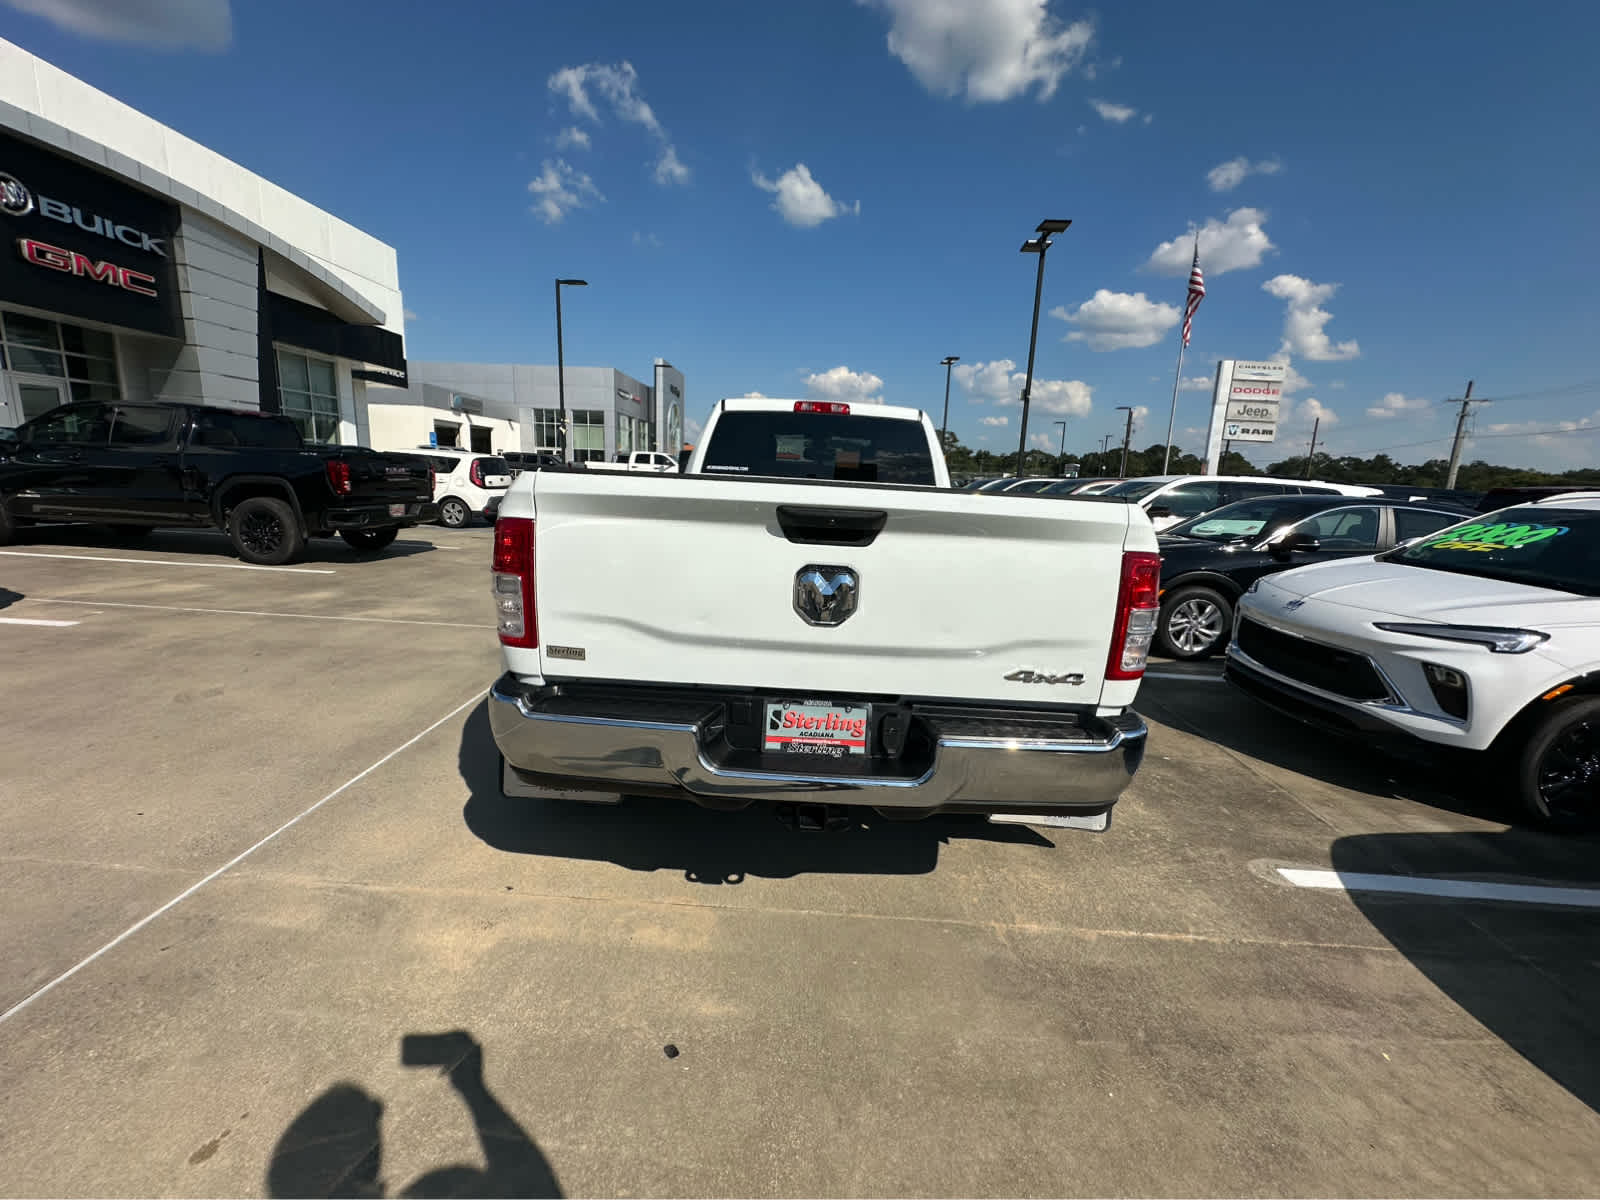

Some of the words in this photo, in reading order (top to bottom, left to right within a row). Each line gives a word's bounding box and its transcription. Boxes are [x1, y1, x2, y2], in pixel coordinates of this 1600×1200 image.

[38, 194, 167, 257] BUICK
[17, 238, 157, 297] GMC
[1233, 387, 1280, 395] DODGE
[1237, 405, 1269, 418] Jeep
[1240, 428, 1274, 436] RAM
[782, 709, 866, 738] Sterling
